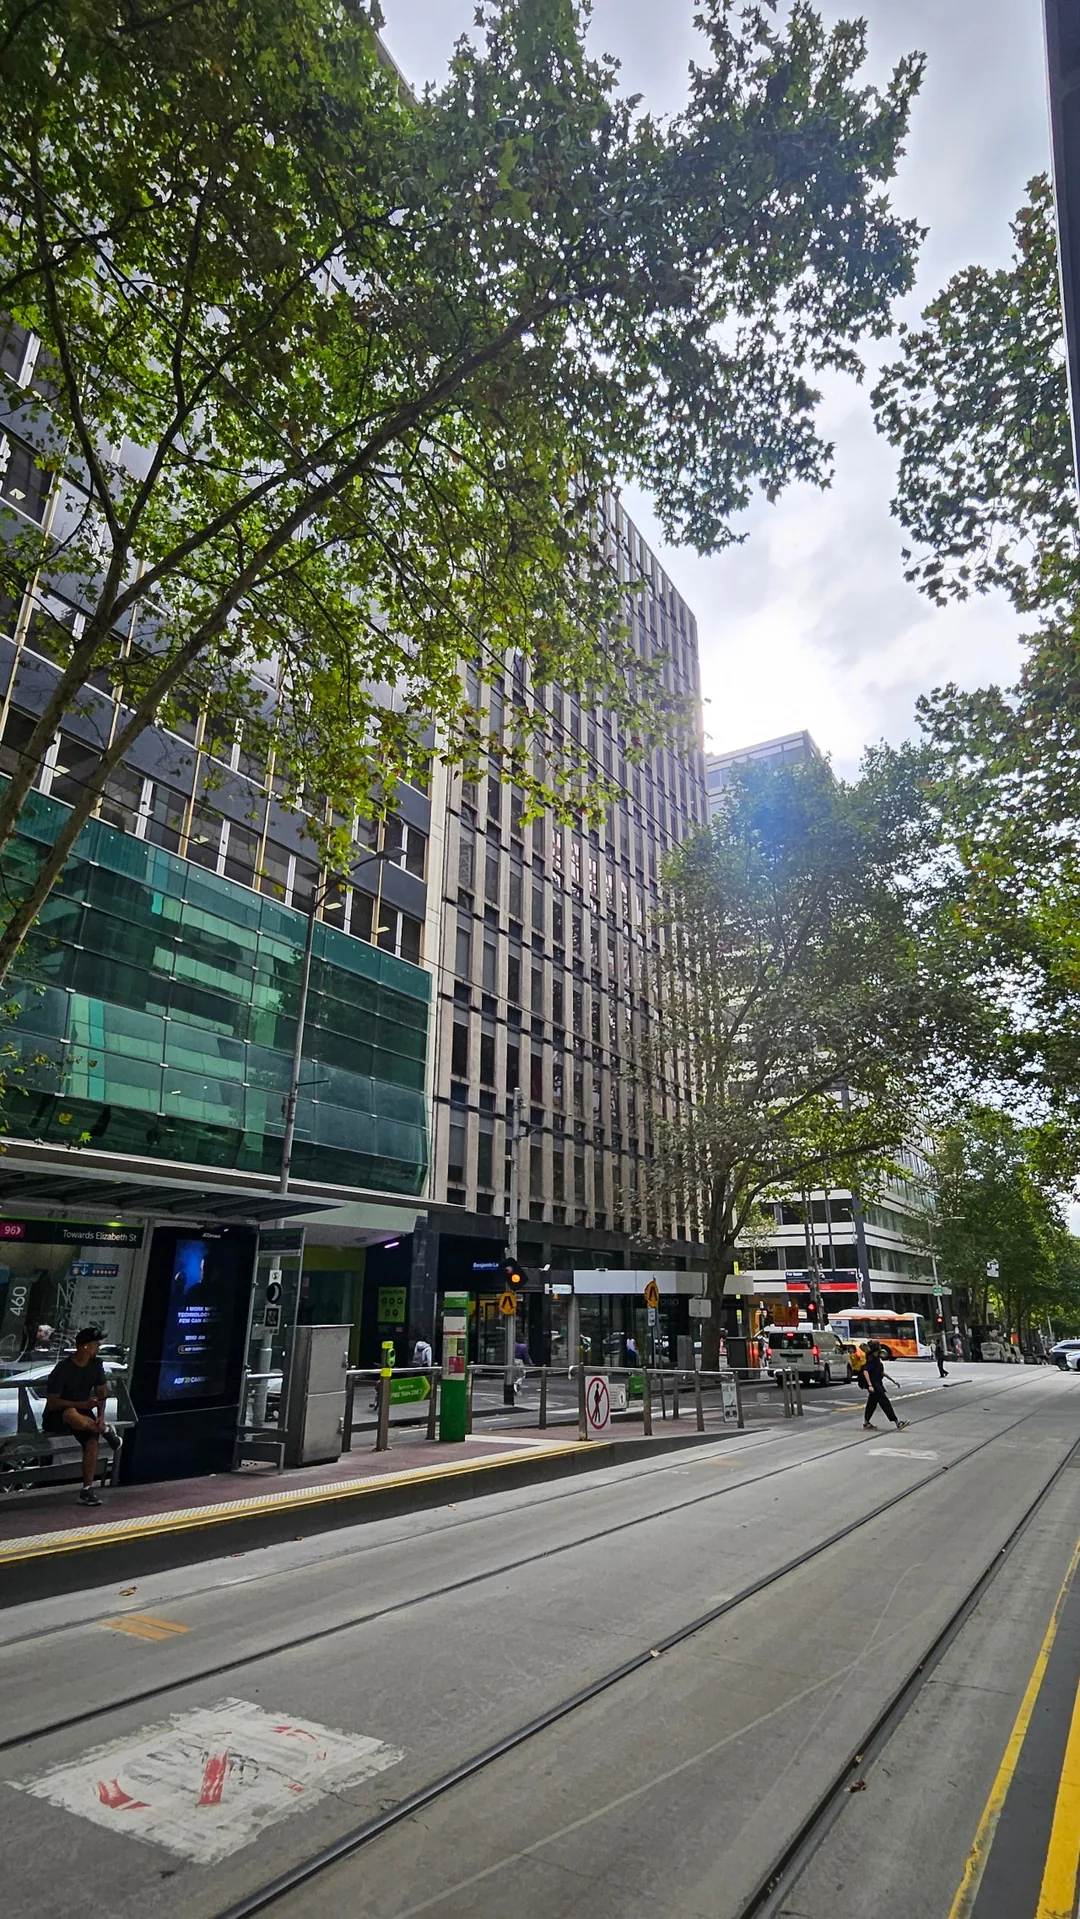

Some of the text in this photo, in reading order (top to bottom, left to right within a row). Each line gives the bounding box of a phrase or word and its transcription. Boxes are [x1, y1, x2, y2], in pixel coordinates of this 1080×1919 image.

[4, 1225, 16, 1235] 96
[63, 1229, 137, 1242] Towards Elizabeth St
[10, 1286, 27, 1316] 460
